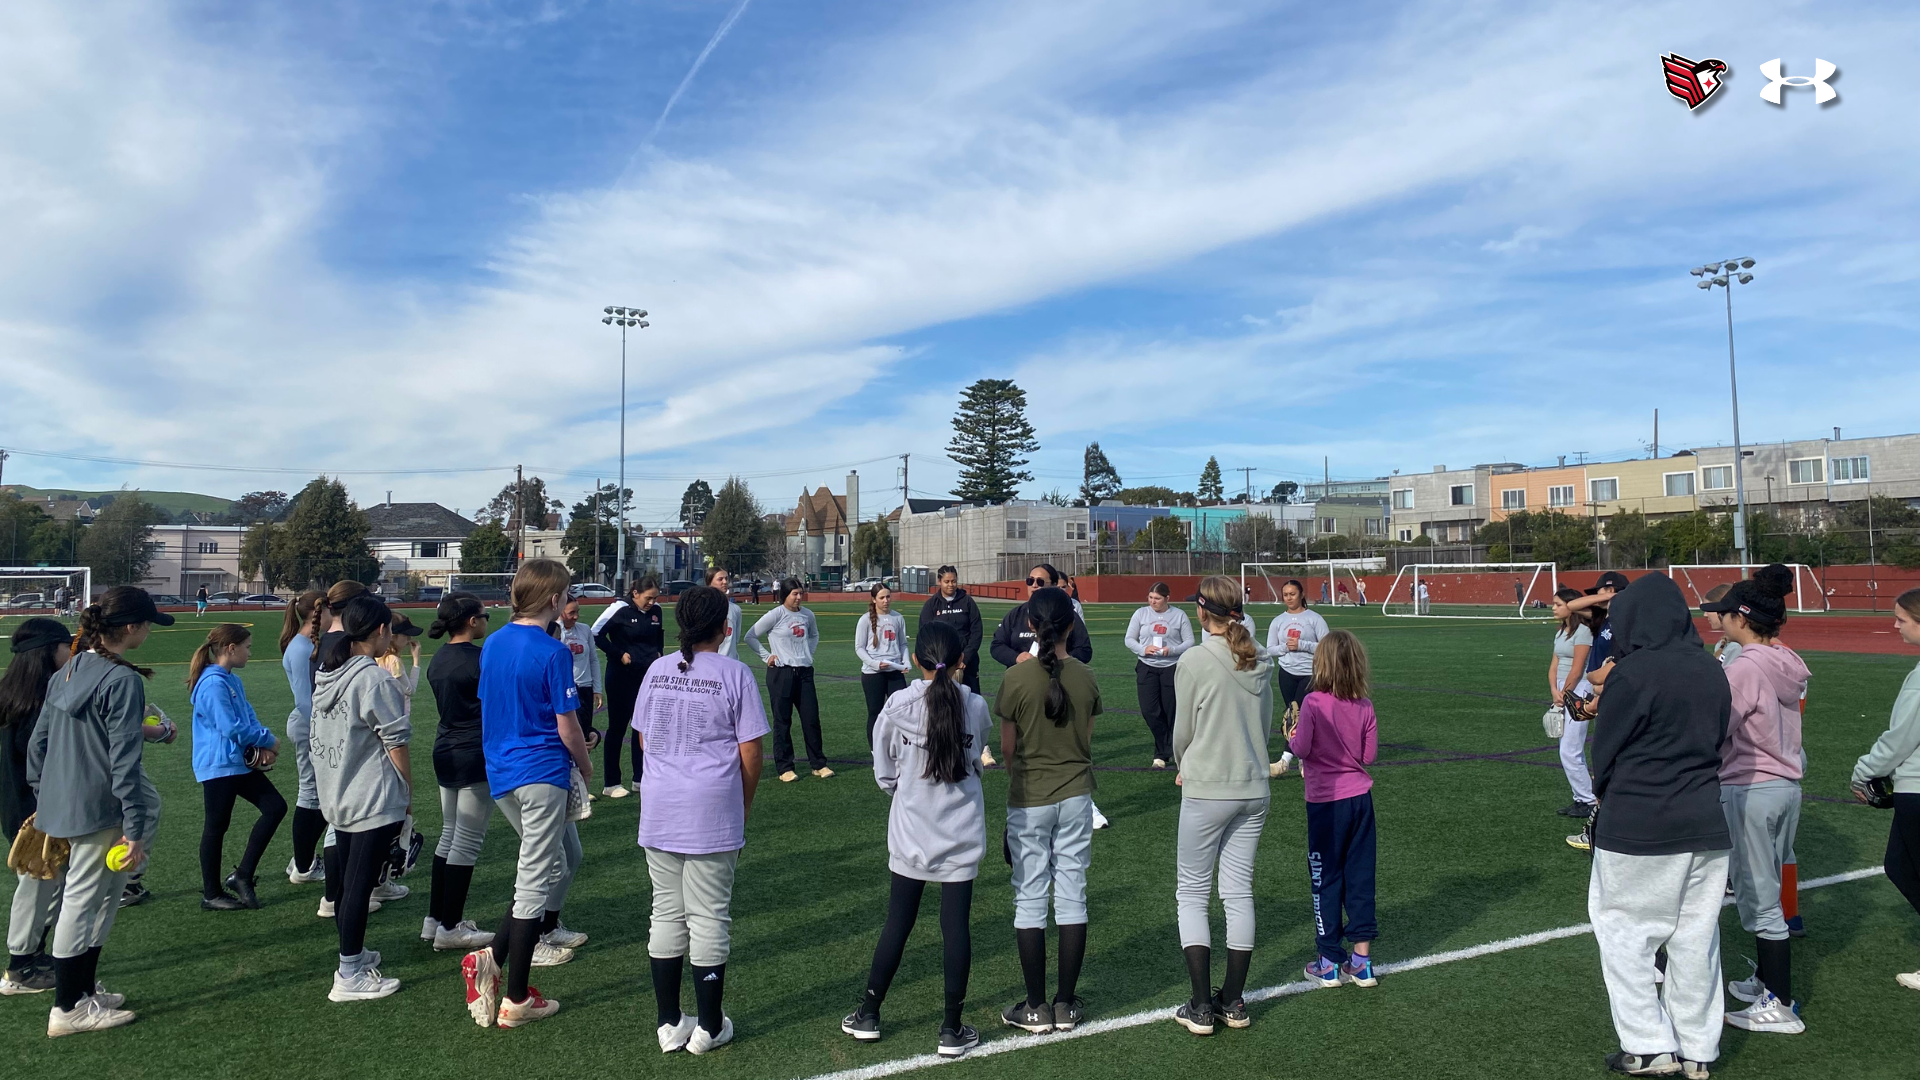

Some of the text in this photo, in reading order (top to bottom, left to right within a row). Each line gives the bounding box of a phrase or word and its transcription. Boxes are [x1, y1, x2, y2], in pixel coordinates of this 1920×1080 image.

[670, 676, 690, 686] STATE
[691, 678, 723, 690] VALKYRIES
[686, 686, 711, 695] SEASON
[1308, 851, 1322, 888] SAINT
